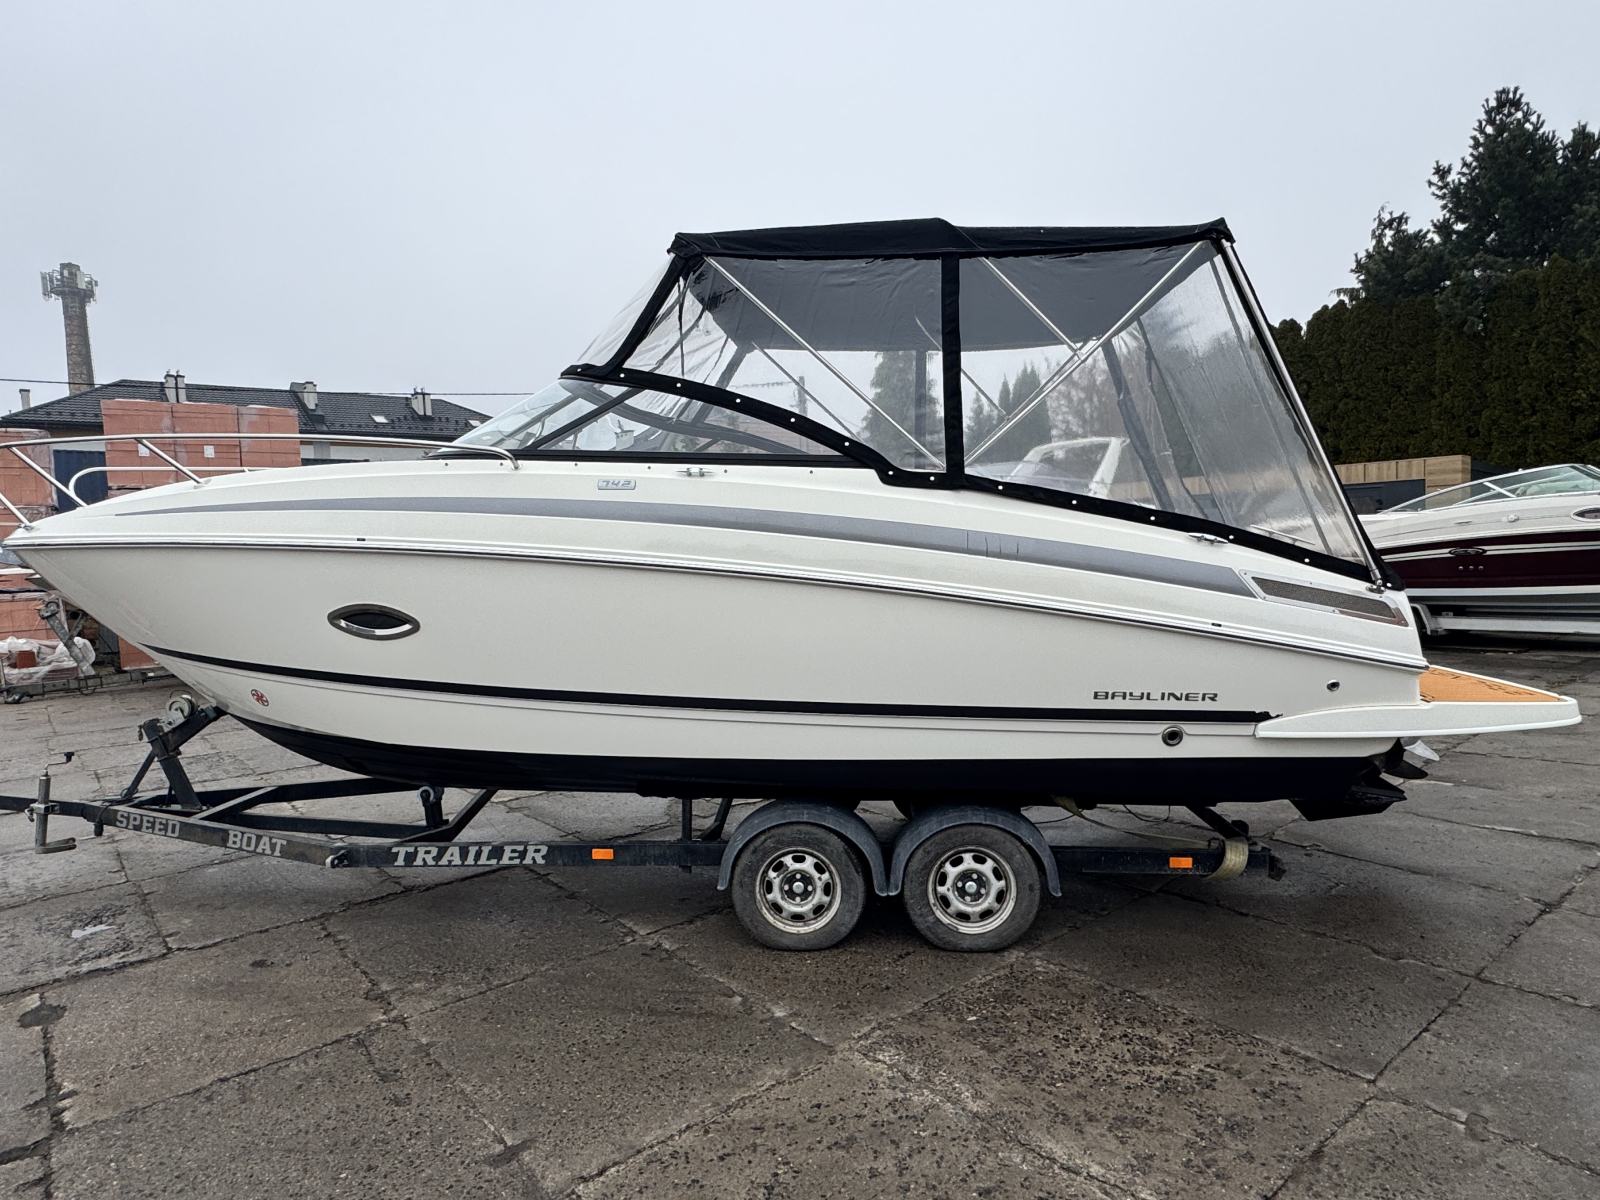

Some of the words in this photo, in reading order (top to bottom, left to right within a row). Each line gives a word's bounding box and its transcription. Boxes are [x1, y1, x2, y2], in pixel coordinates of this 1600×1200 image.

[1093, 691, 1219, 702] BAYLINER
[116, 811, 180, 838] SPEED
[227, 830, 287, 857] BOAT
[391, 844, 549, 866] TRAILER
